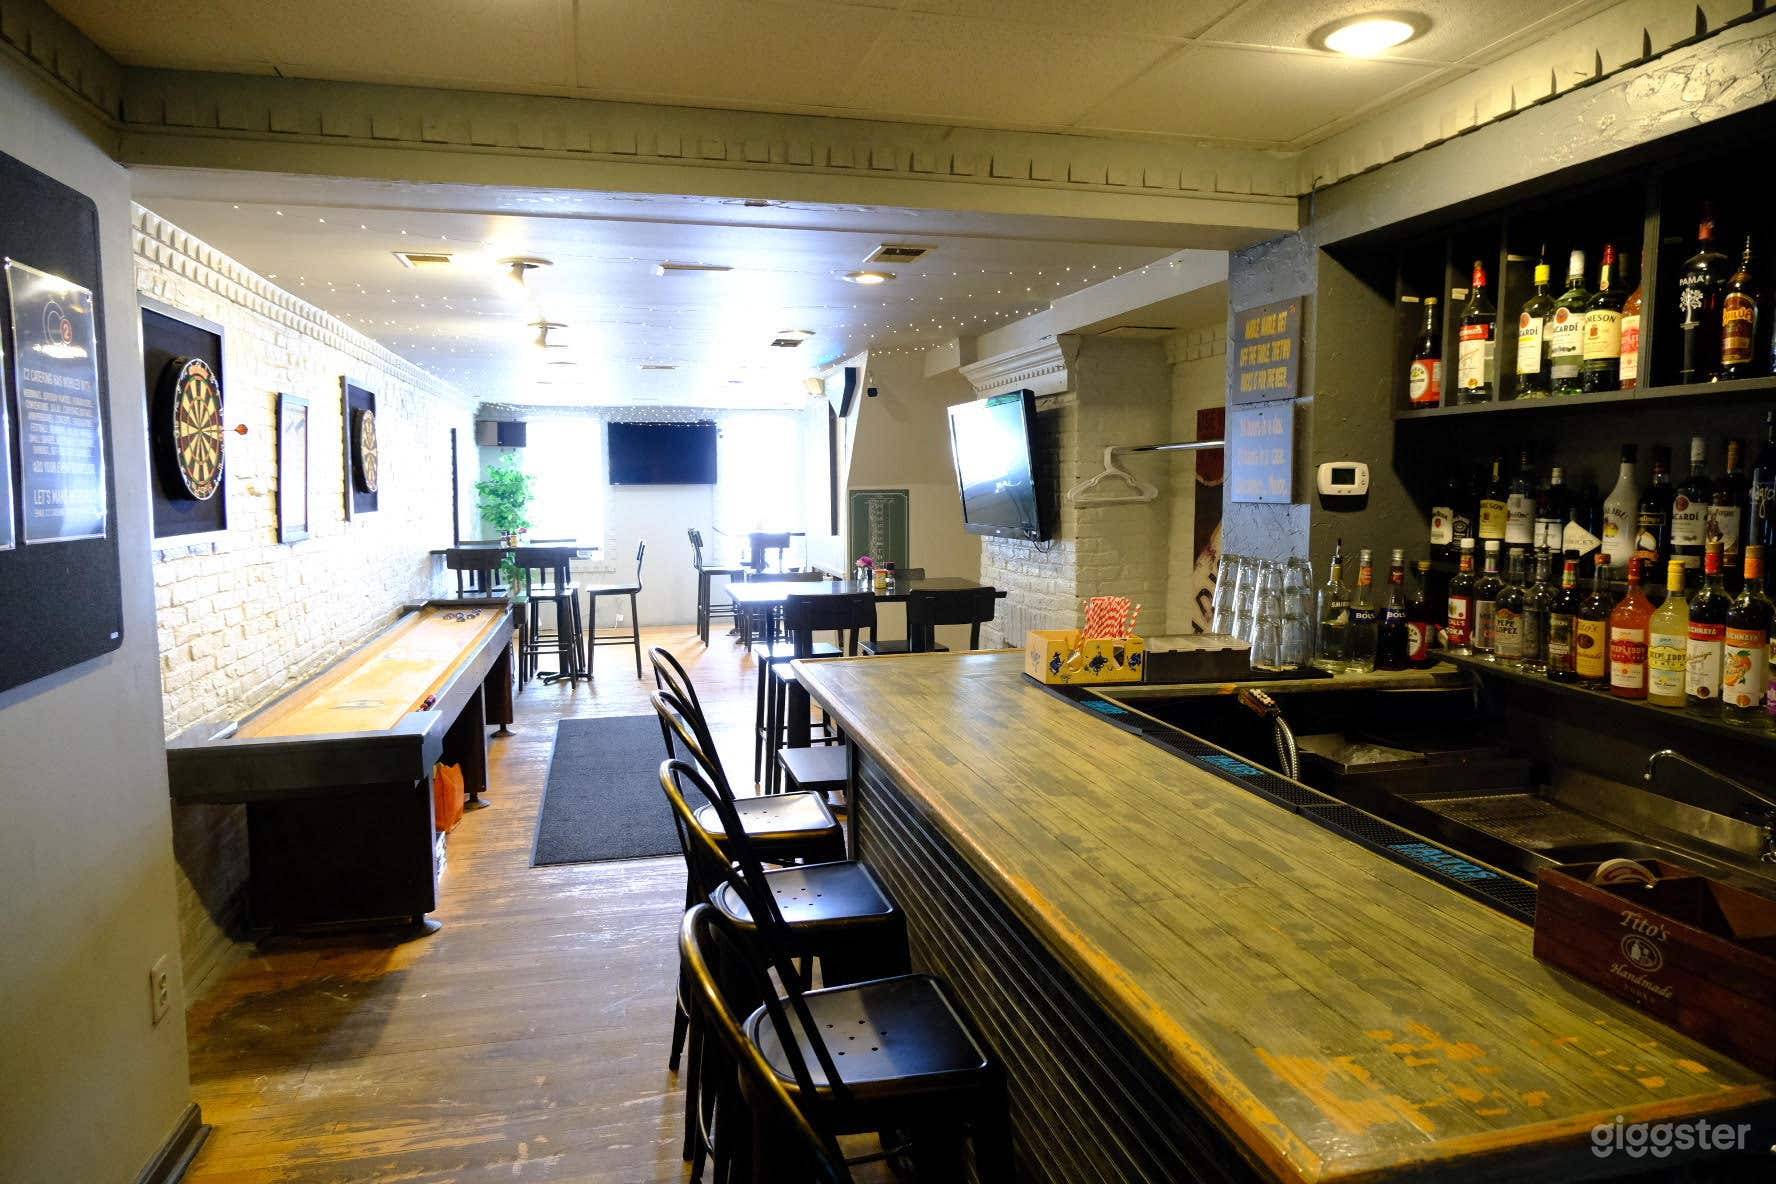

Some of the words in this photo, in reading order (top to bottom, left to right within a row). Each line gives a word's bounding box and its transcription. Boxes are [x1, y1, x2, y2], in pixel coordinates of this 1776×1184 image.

[1679, 275, 1704, 286] PAMA
[1620, 910, 1671, 941] Tito's
[1610, 963, 1673, 999] Handmade
